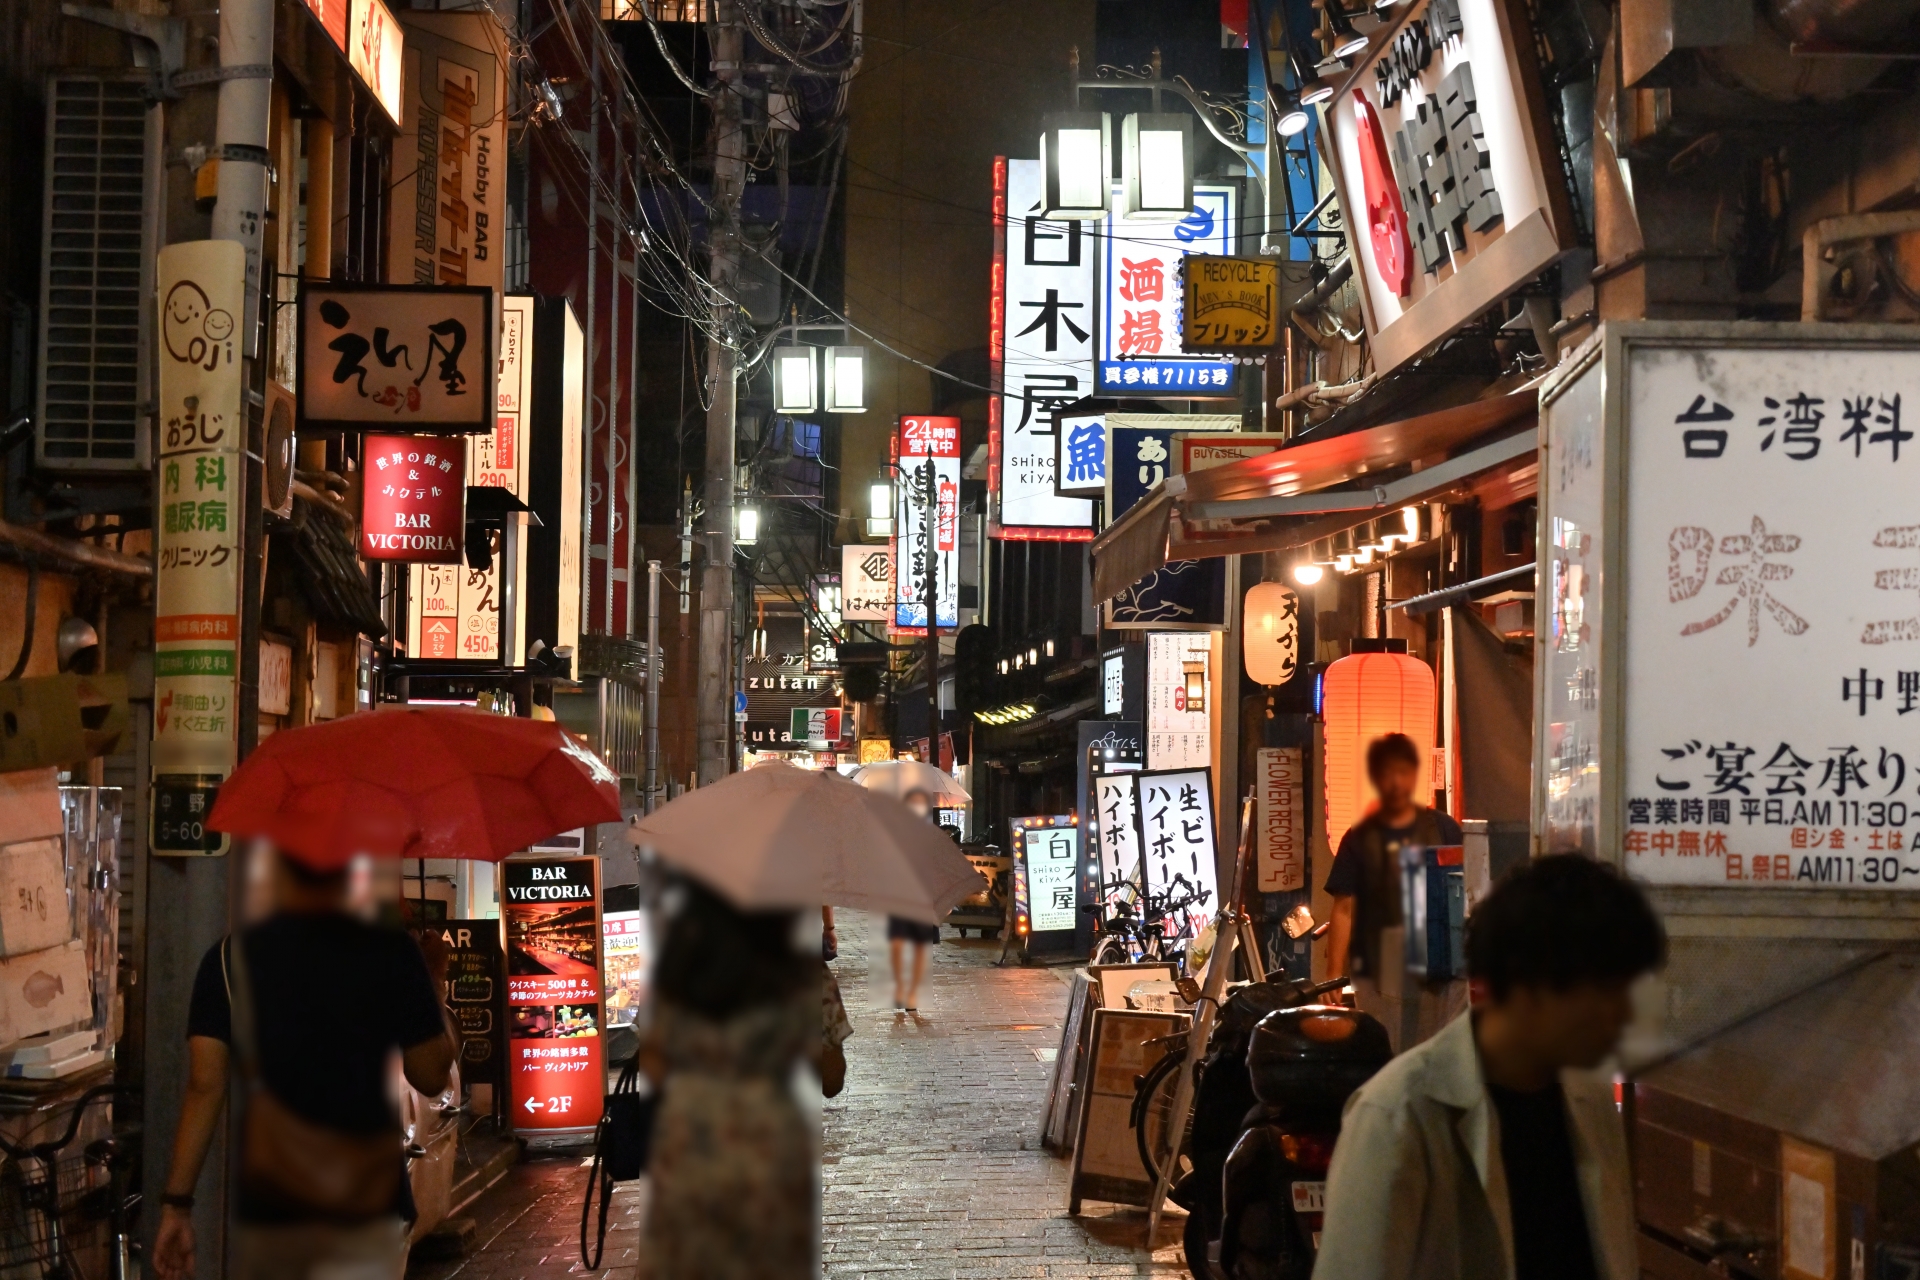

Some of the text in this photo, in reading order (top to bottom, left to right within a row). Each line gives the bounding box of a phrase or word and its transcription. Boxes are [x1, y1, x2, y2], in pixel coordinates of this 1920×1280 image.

[473, 134, 490, 262] Hobby BAR
[1203, 262, 1261, 283] RECYCLE
[1118, 257, 1164, 354] 酒場
[1239, 290, 1266, 306] BOOK
[1014, 198, 1091, 436] 白木屋
[1193, 323, 1270, 343] ブリッジ
[1104, 367, 1229, 386] 買参権7115号
[166, 413, 225, 448] おうじ
[904, 420, 956, 439] 24時間
[1675, 391, 1914, 463] 台湾料
[908, 439, 954, 454] 営業中
[1066, 422, 1105, 483] 魚
[375, 452, 453, 473] 世界の銘酒
[165, 456, 227, 494] 内科
[408, 469, 419, 480] &
[382, 484, 442, 499] カクテル
[164, 500, 227, 534] 糖尿病
[394, 512, 431, 528] BAR
[367, 533, 456, 550] VICTORIA
[161, 544, 231, 571] クリニック
[948, 583, 956, 621] 中野本店
[464, 635, 494, 653] 450円
[173, 715, 227, 733] すぐ左折
[1656, 739, 1920, 797] ご宴会承り
[161, 793, 205, 813] 中野
[1628, 798, 1731, 825] 営業時間
[162, 821, 203, 840] 5-60
[1267, 755, 1297, 886] FLOWER RECORD 3F
[1103, 785, 1126, 893] ハイボール
[1179, 783, 1209, 907] 生ビール
[1624, 828, 1728, 857] 年中無休
[531, 866, 567, 880] BAR
[508, 885, 592, 900] VICTORIA
[581, 979, 589, 987] &
[510, 990, 596, 1001] 季節のフルーツカクテル
[523, 1046, 588, 1059] 世界の銘酒多数
[544, 1062, 588, 1072] ヴィクトリア
[548, 1095, 572, 1113] 2F
